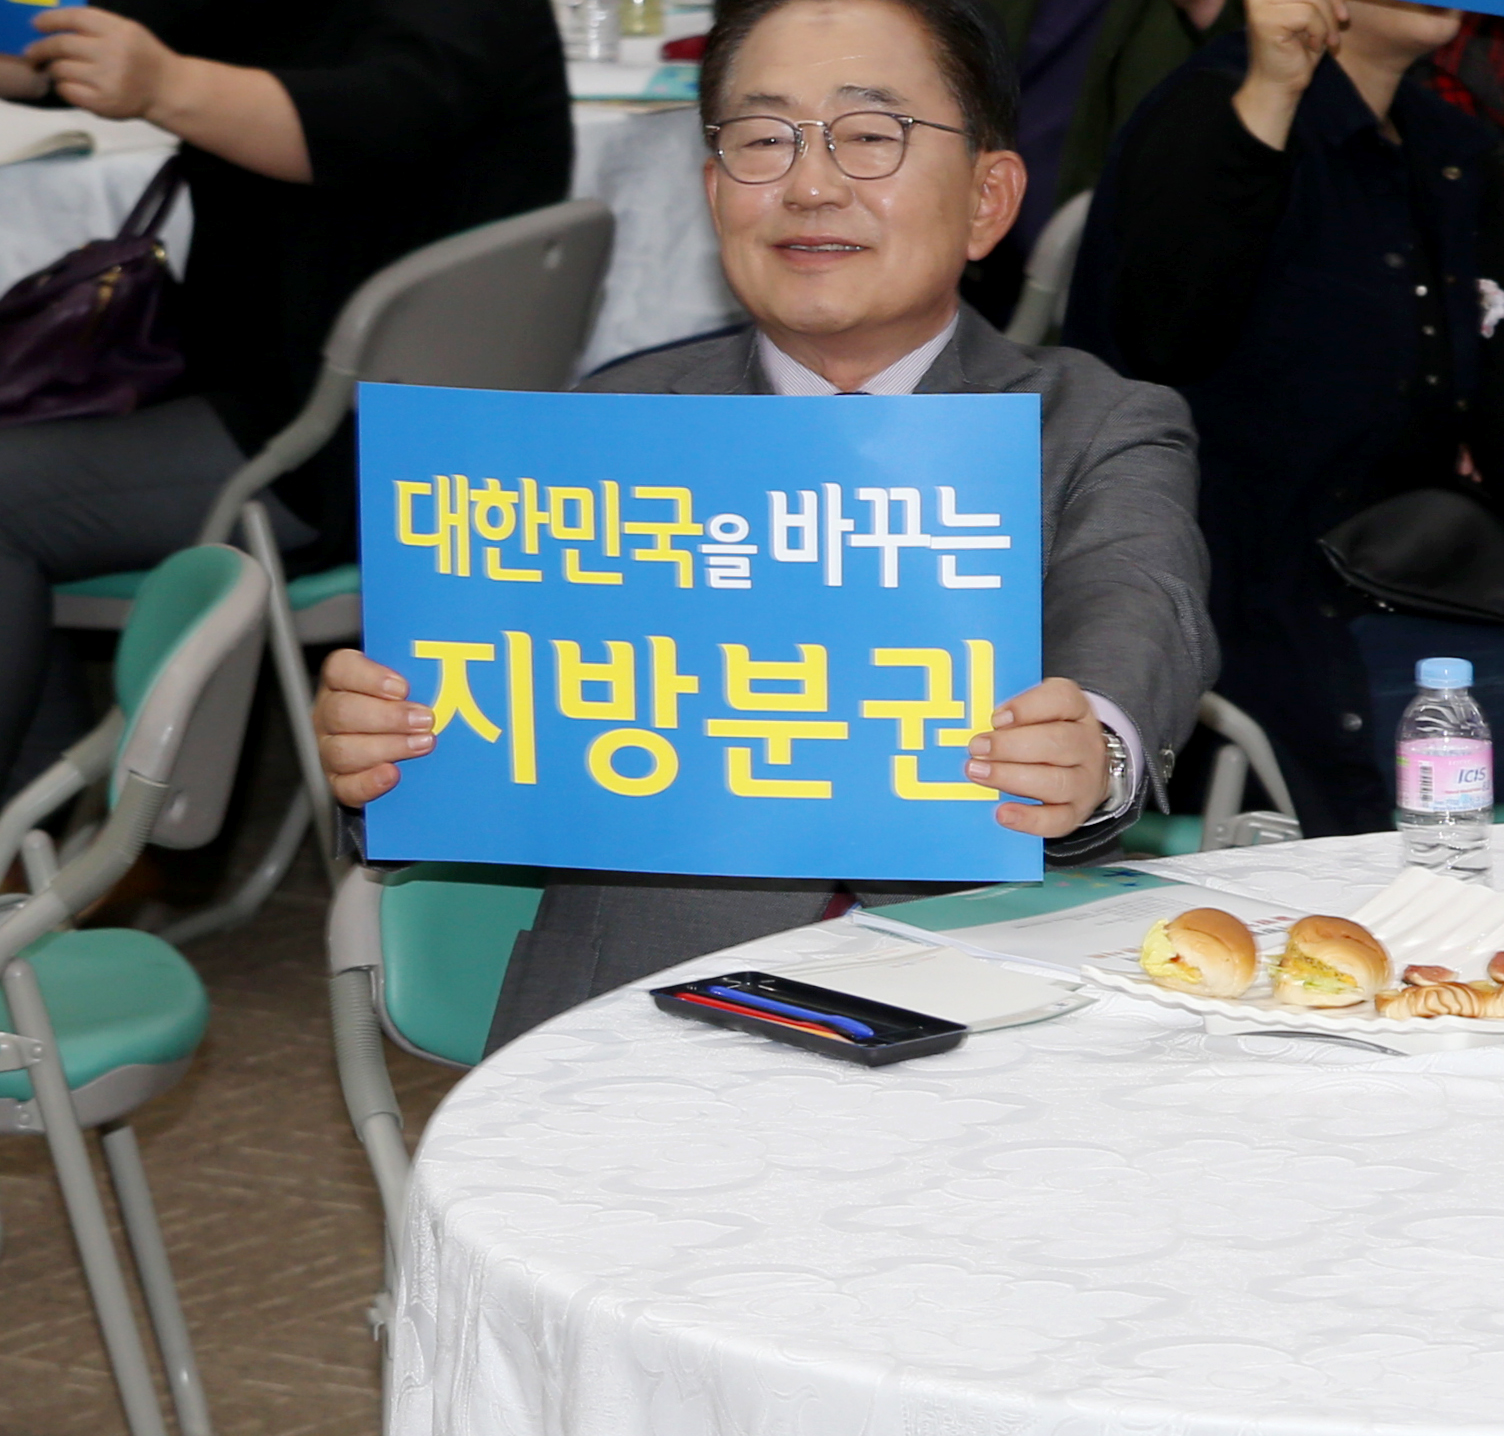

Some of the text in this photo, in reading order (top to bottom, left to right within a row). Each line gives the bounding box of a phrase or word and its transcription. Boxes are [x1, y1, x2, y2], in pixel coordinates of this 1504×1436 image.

[394, 474, 1012, 590] 대한민국을 바꾸는
[411, 630, 1002, 801] 지방분권
[1458, 767, 1486, 783] ICIS
